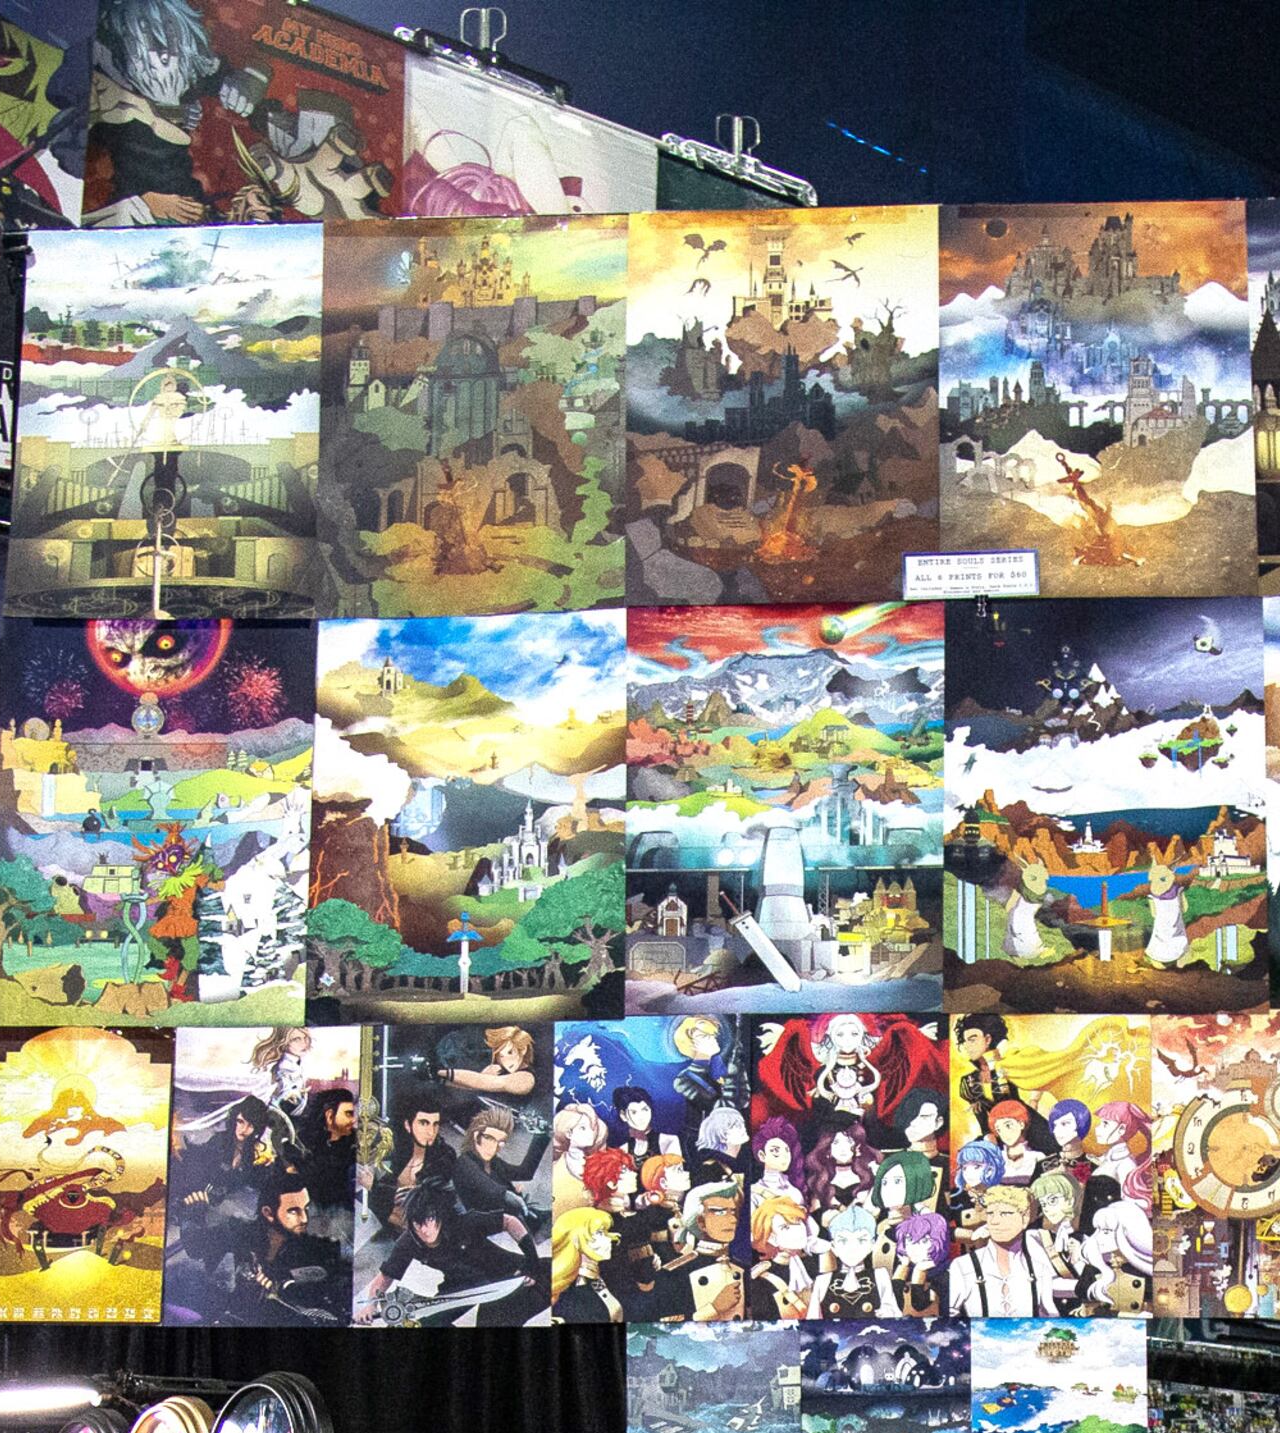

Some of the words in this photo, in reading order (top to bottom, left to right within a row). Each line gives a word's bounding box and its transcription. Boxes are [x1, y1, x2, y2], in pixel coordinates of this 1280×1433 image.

[281, 17, 312, 38] MY
[252, 24, 391, 92] ACADEMIA
[990, 556, 1024, 564] SERIES
[948, 573, 982, 581] PRINTS
[988, 572, 1005, 580] FOR
